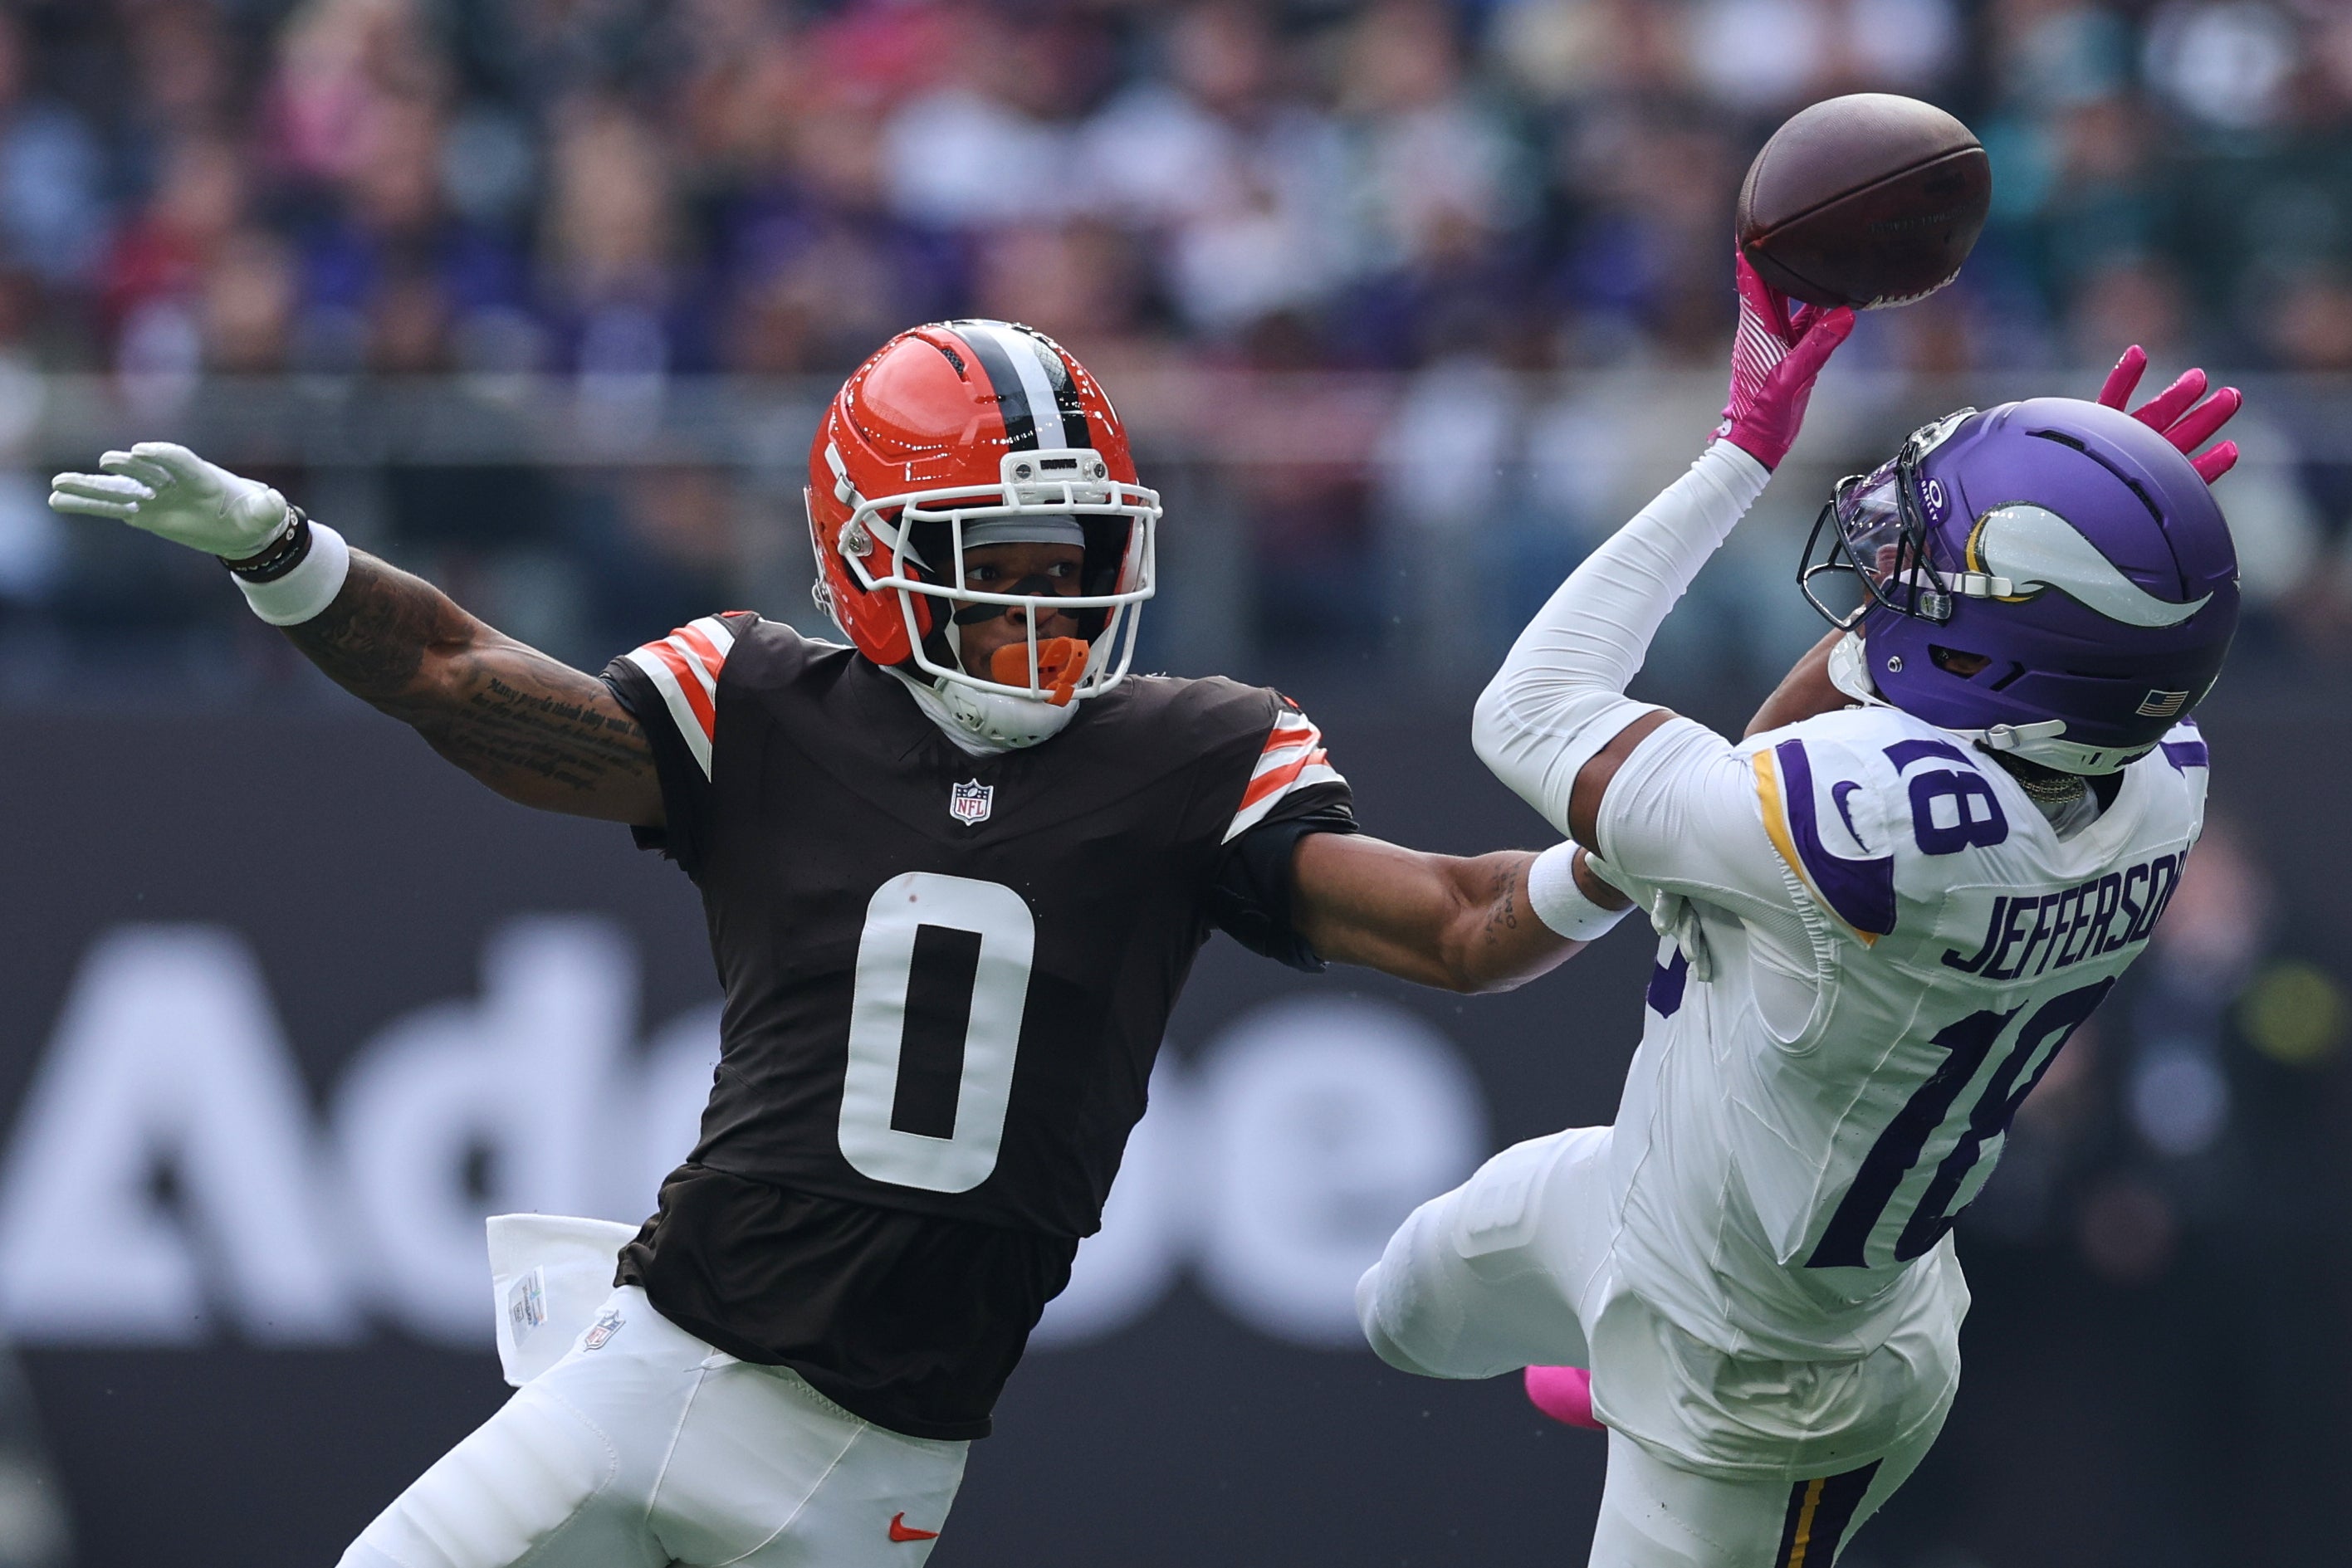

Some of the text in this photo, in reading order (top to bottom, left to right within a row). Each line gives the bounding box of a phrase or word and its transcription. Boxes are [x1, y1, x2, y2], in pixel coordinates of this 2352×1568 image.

[1039, 457, 1078, 470] BROWNS
[1921, 480, 1939, 521] OAKLEY
[957, 798, 984, 816] NFL
[1882, 738, 2009, 855] 18
[838, 872, 1035, 1194] 0
[0, 915, 1486, 1346] Ade
[1804, 975, 2115, 1268] 18
